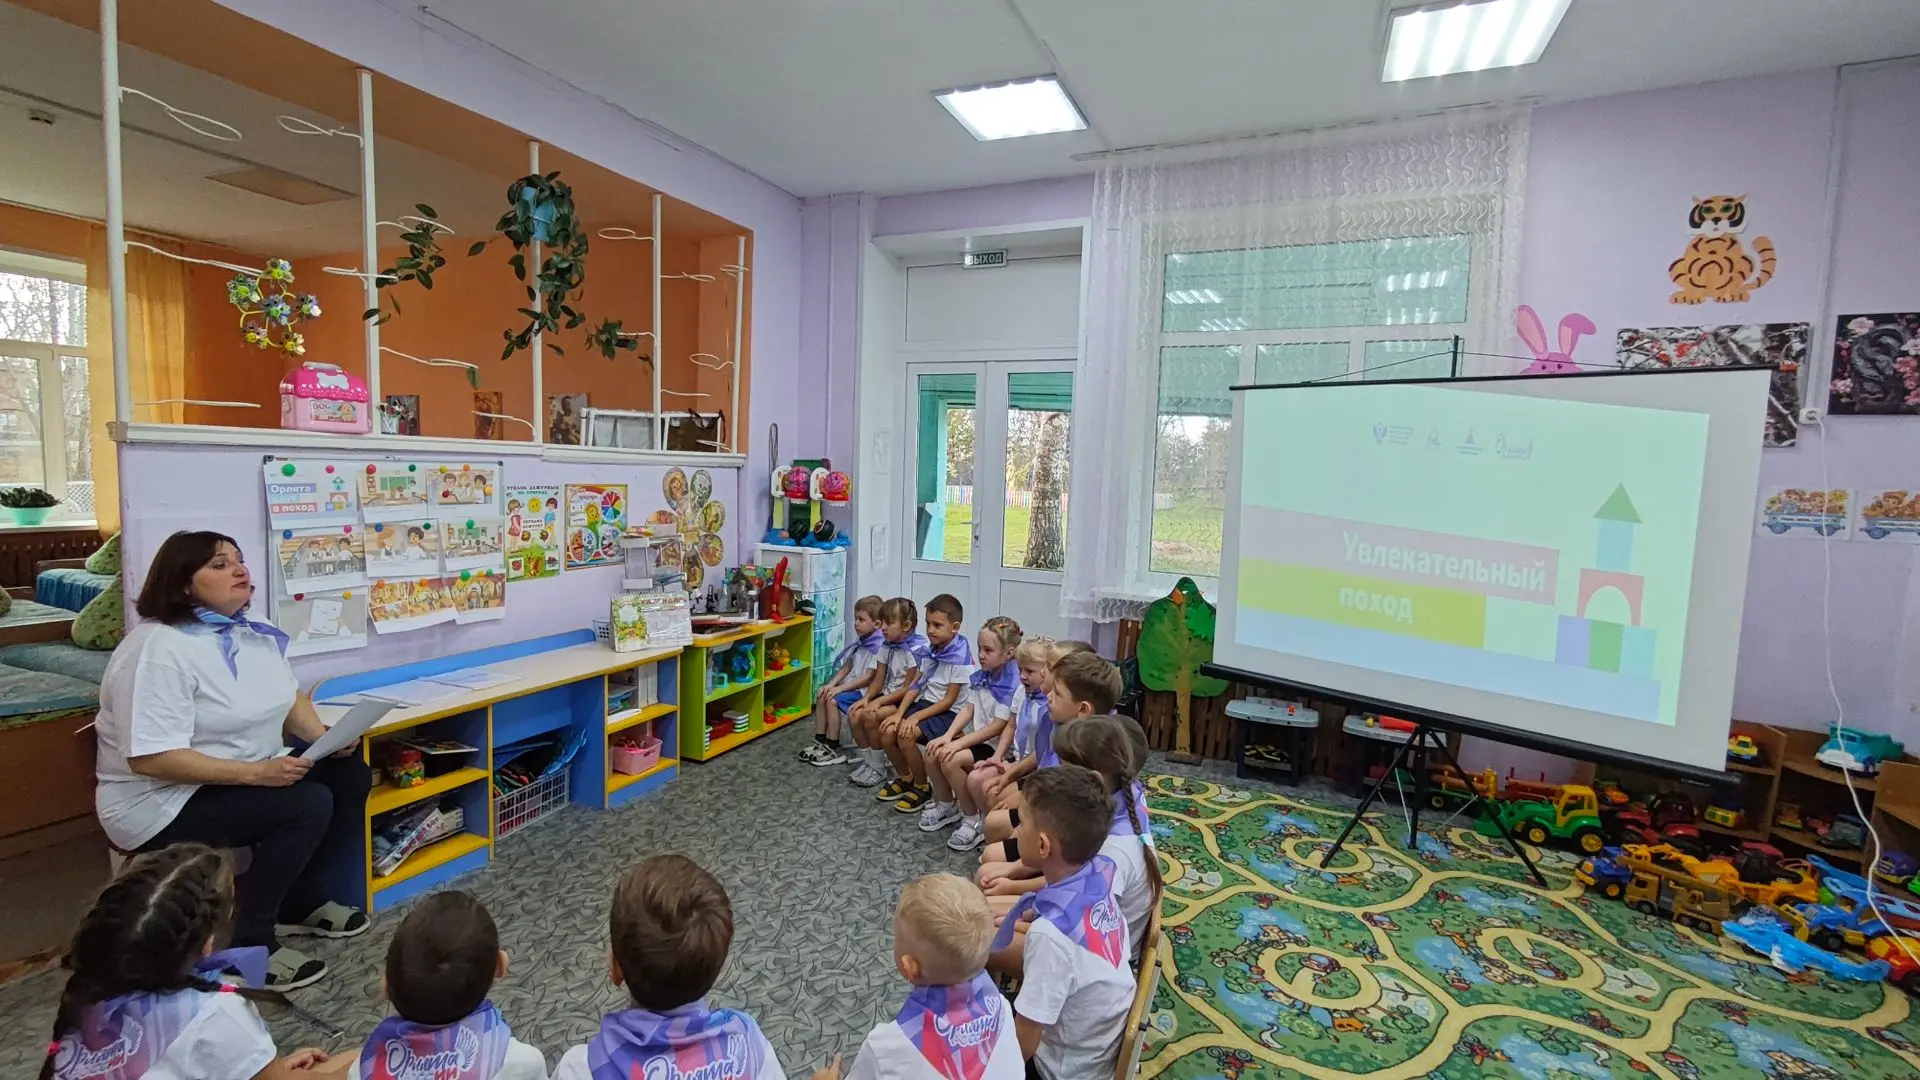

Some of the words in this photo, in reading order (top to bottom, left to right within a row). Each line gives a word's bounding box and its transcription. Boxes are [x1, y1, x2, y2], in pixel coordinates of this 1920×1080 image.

[967, 253, 1002, 265] ВЫХОД
[270, 484, 311, 494] Орлята
[282, 504, 315, 513] поход
[1342, 530, 1547, 592] Увлекательный
[1339, 586, 1414, 624] поход
[386, 1039, 459, 1078] Орлята
